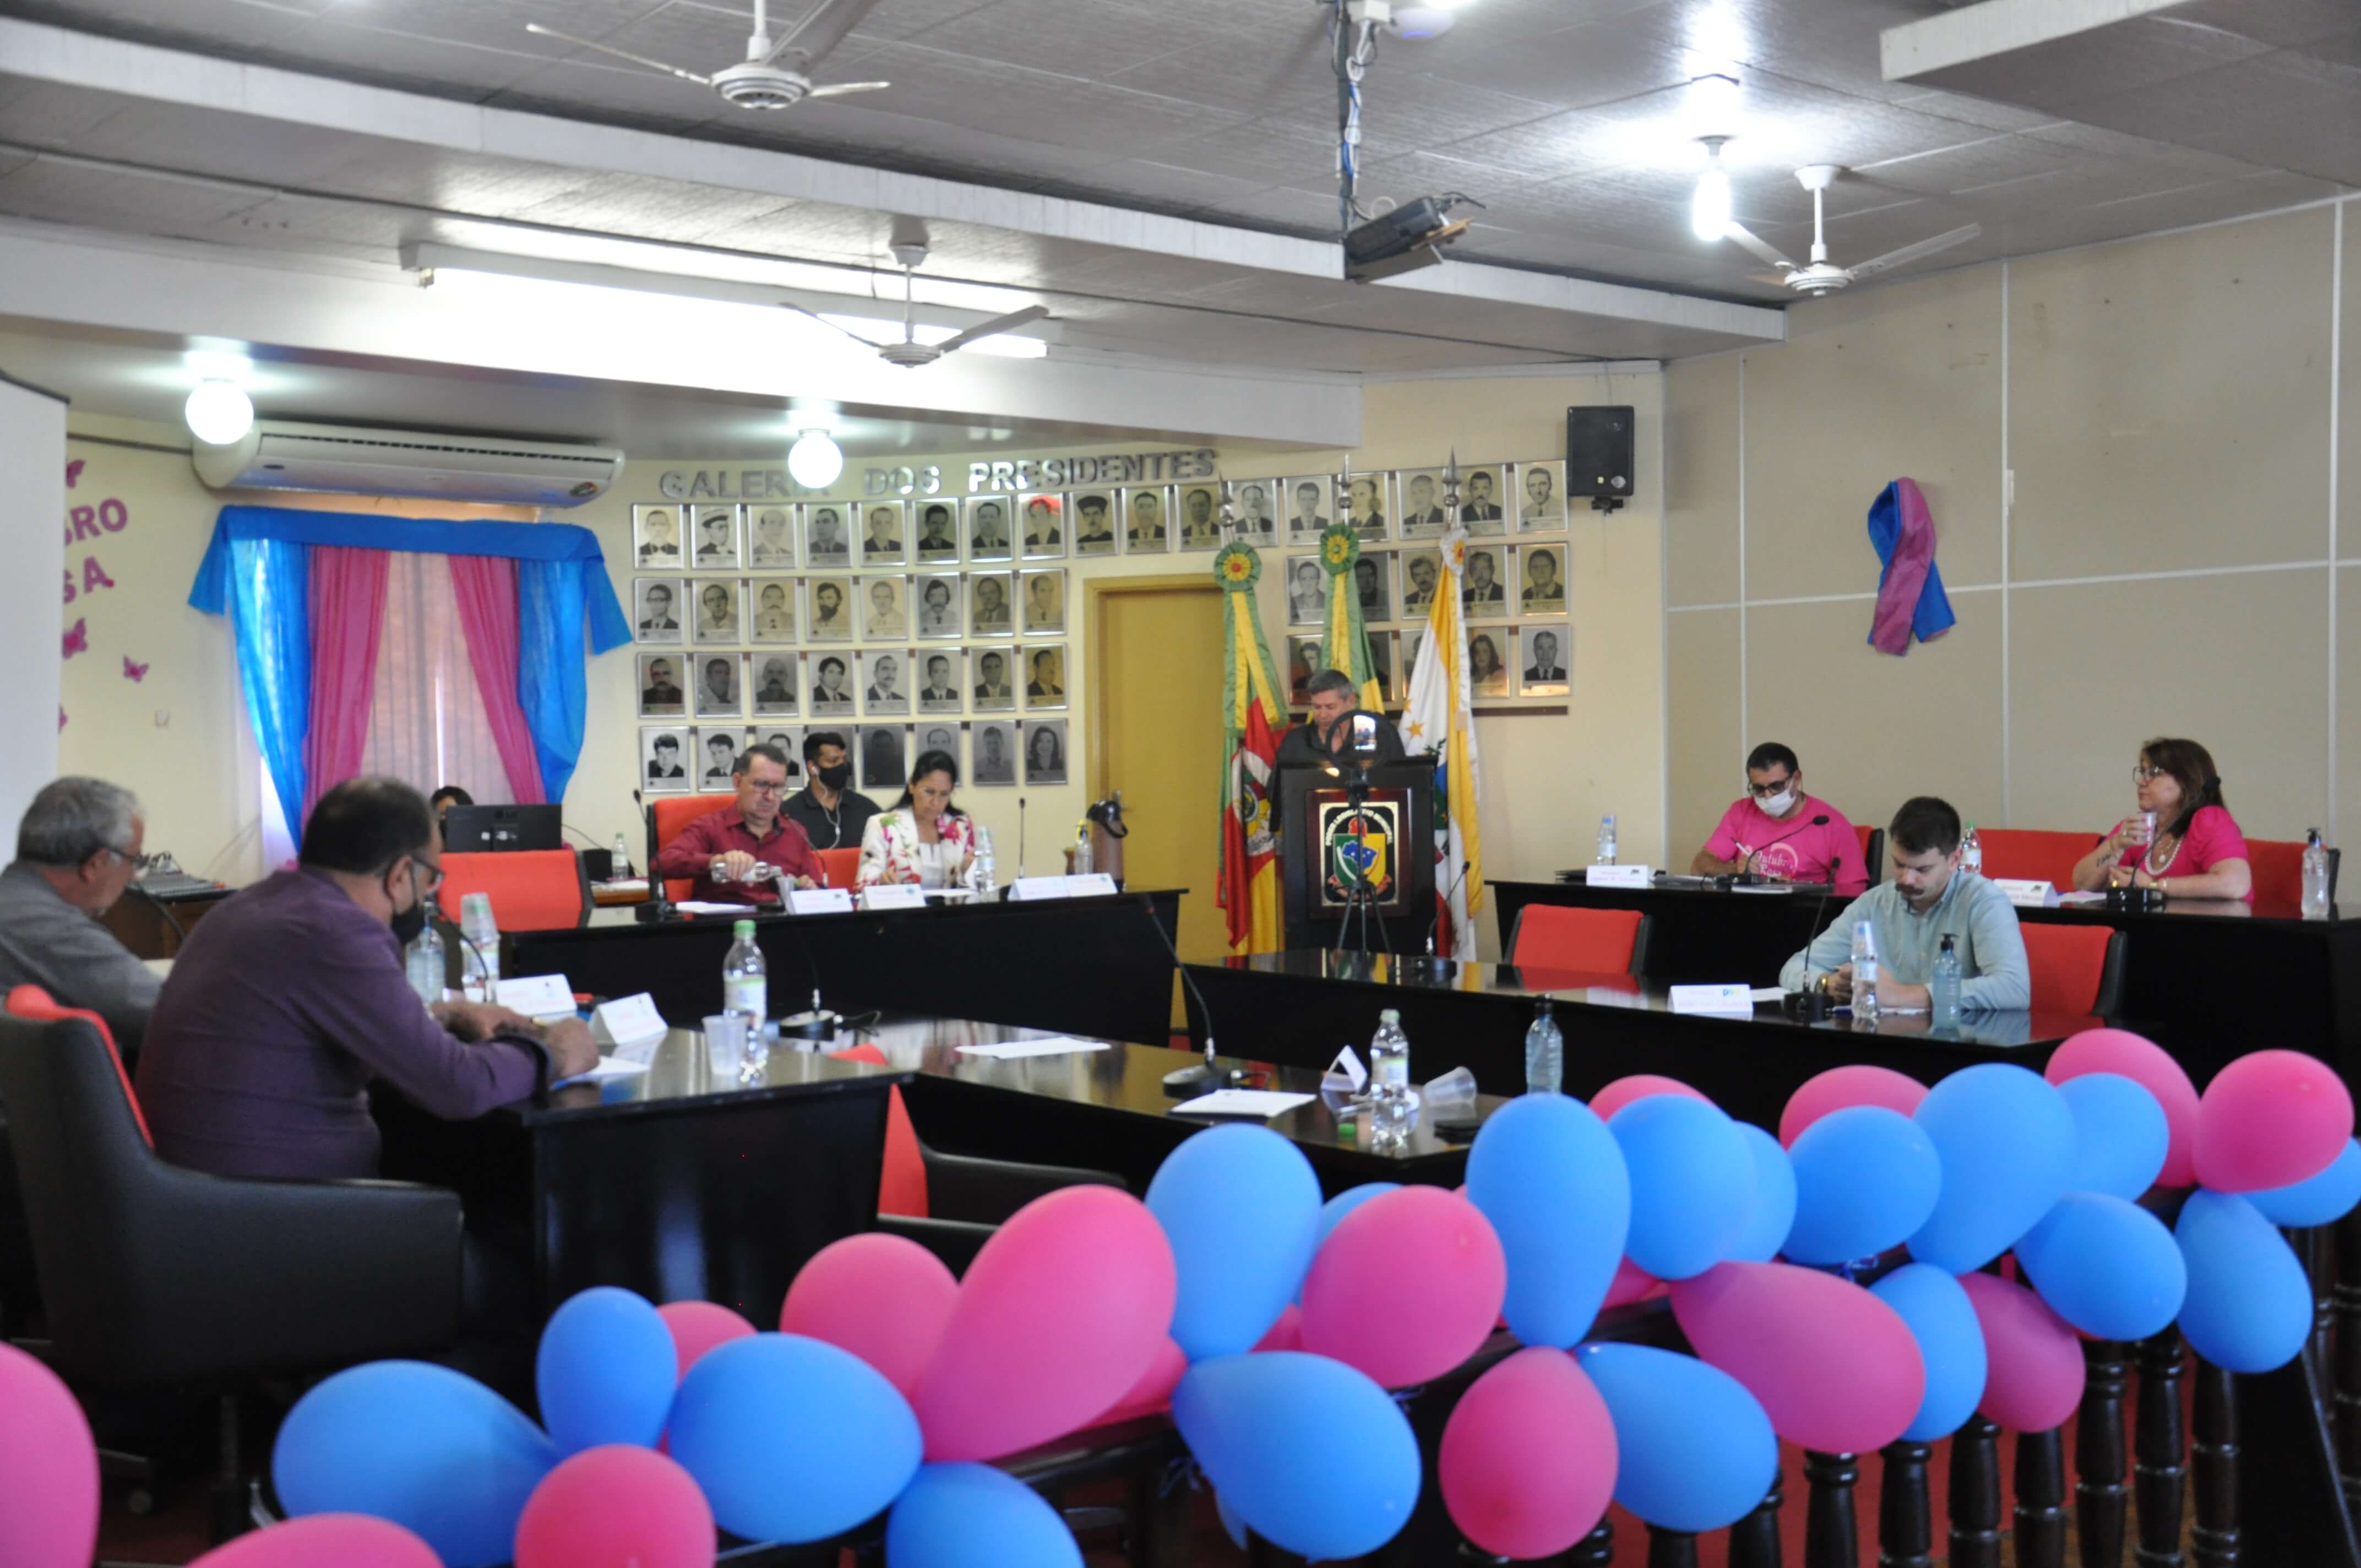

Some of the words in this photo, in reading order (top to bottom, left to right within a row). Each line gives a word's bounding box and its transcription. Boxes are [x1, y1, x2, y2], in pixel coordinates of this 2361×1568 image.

[864, 466, 940, 495] DOS
[969, 448, 1216, 493] PRESIDENTES
[64, 498, 128, 547] RO
